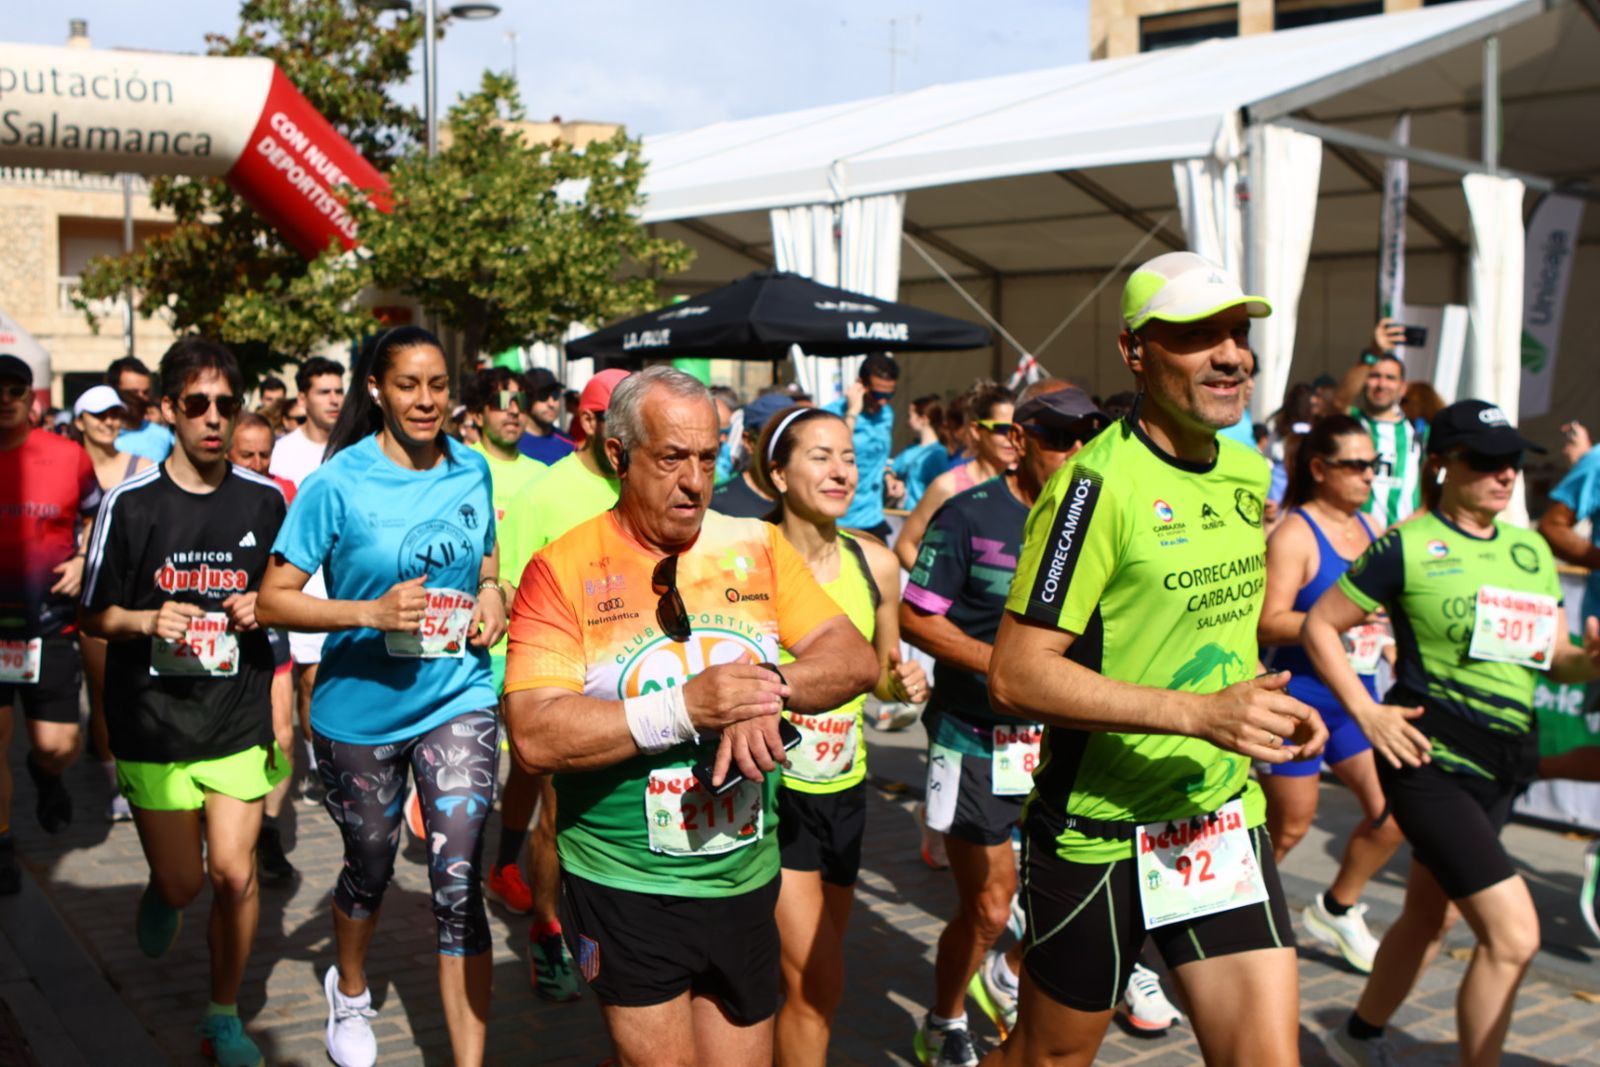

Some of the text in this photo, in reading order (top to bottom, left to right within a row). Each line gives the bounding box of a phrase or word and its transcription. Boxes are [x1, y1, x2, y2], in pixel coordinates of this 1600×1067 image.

[1, 110, 213, 157] Salamanca
[270, 111, 310, 152] CON
[257, 136, 359, 239] DEPORTISTAS
[173, 550, 233, 563] IBÉRICOS
[1041, 478, 1092, 603] CORRECAMINOS
[1163, 551, 1266, 591] CORRECAMIN
[418, 616, 449, 637] 54
[587, 611, 640, 627] Helmántica
[1496, 618, 1534, 643] 301
[615, 613, 764, 665] CLUB PORTIVO
[816, 741, 844, 762] 99
[1024, 753, 1038, 772] 8
[680, 797, 736, 831] 211
[1175, 850, 1215, 887] 92
